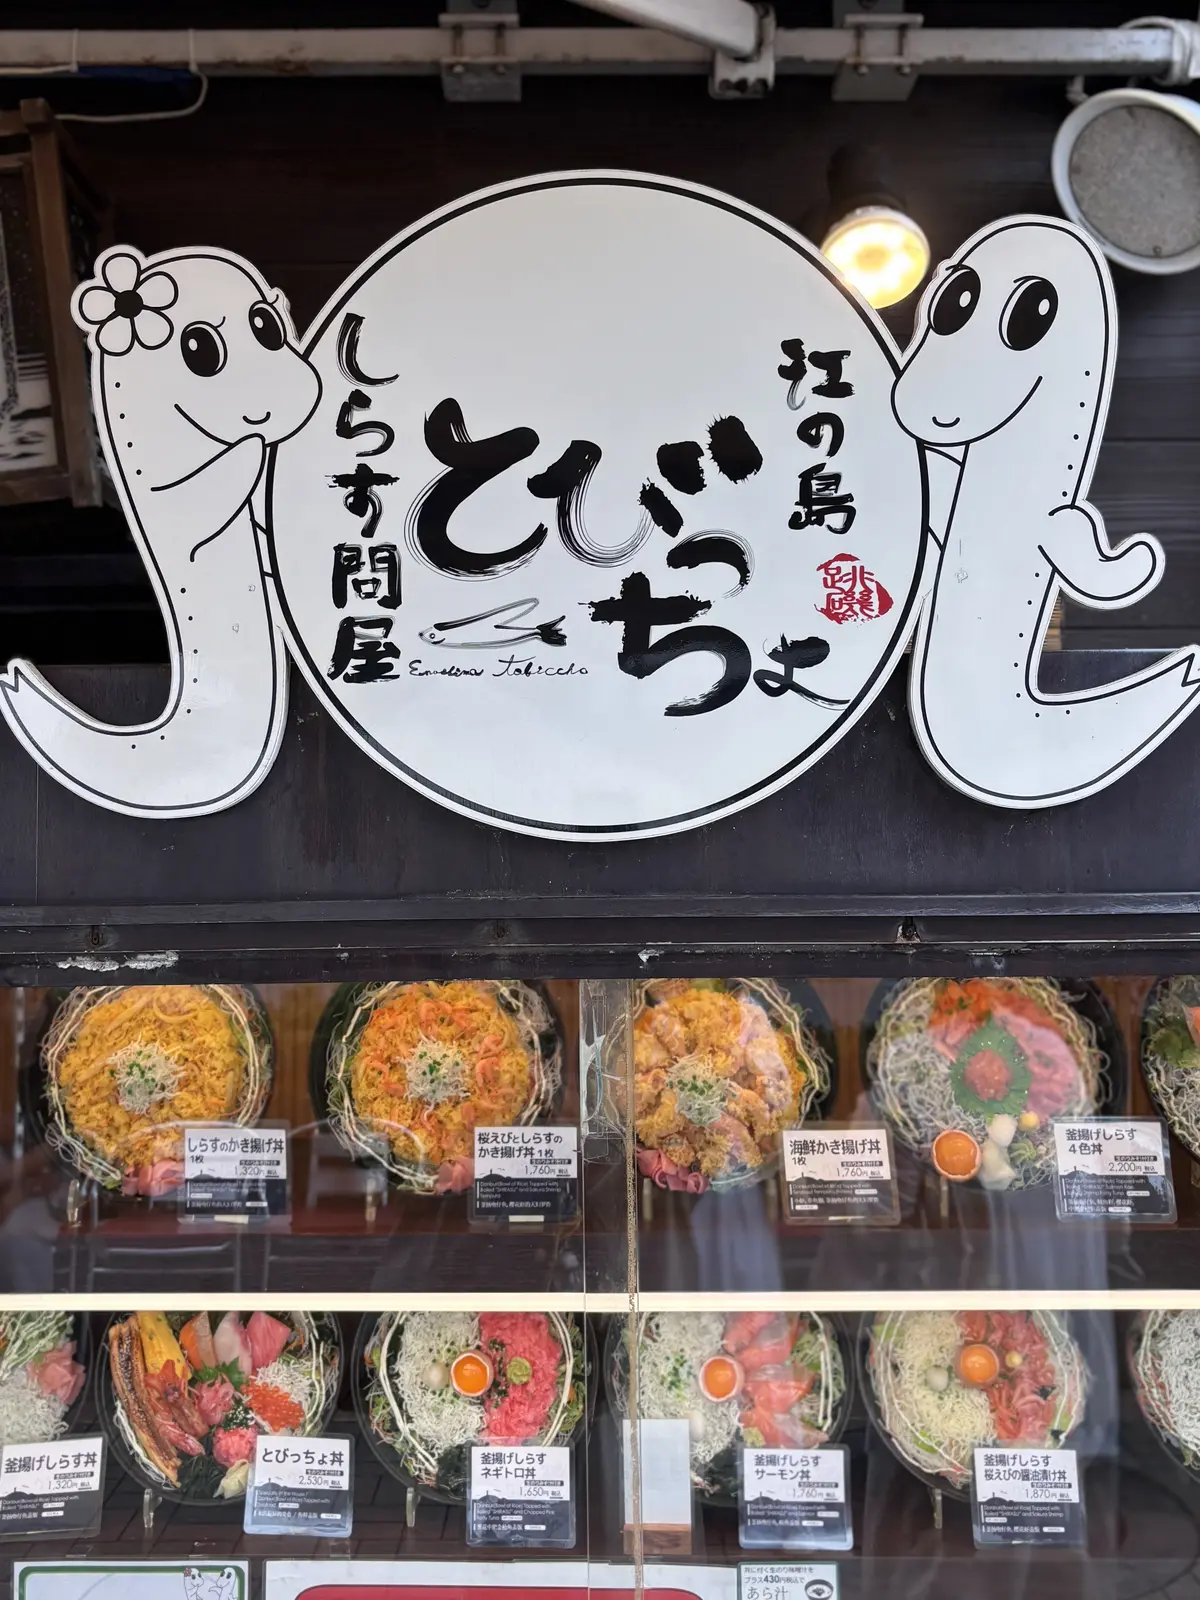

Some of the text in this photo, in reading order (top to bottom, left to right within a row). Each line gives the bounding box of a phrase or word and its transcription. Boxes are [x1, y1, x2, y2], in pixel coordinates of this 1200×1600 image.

[778, 337, 858, 536] 江の島
[325, 313, 403, 685] しらす問屋
[477, 1132, 563, 1145] 桜えびとしらすの
[1065, 1128, 1137, 1141] 釜揚げしらす
[188, 1137, 285, 1154] しらすのかき揚げ丼
[789, 1138, 882, 1156] 海鮮かき揚げ丼
[1068, 1142, 1103, 1155] 4色丼
[478, 1146, 554, 1159] かき揚げ丼 1枚
[792, 1156, 807, 1166] 1枚
[1108, 1162, 1142, 1172] 2,200円
[234, 1166, 265, 1176] 1,320円
[525, 1165, 556, 1176] 1,760円
[836, 1167, 868, 1178] 1,760円
[4, 1451, 98, 1474] 釜揚げしらす丼
[262, 1448, 344, 1466] とびっちょ丼
[480, 1452, 547, 1465] 釜揚げしらす
[754, 1454, 822, 1467] 釜揚げしらす
[984, 1454, 1052, 1467] 釜揚げしらす
[480, 1467, 537, 1480] ネギトロ丼
[755, 1470, 811, 1481] サーモン丼
[984, 1468, 1067, 1481] 桜えびの醤油漬け丼
[48, 1480, 78, 1490] 1,320円
[298, 1475, 329, 1486] 2,530円
[519, 1487, 549, 1497] 1,650円
[792, 1488, 823, 1499] 1,760円
[1025, 1489, 1058, 1499] 1,870円
[744, 1575, 806, 1584] プラス430円税込で
[747, 1586, 789, 1600] あら汁
